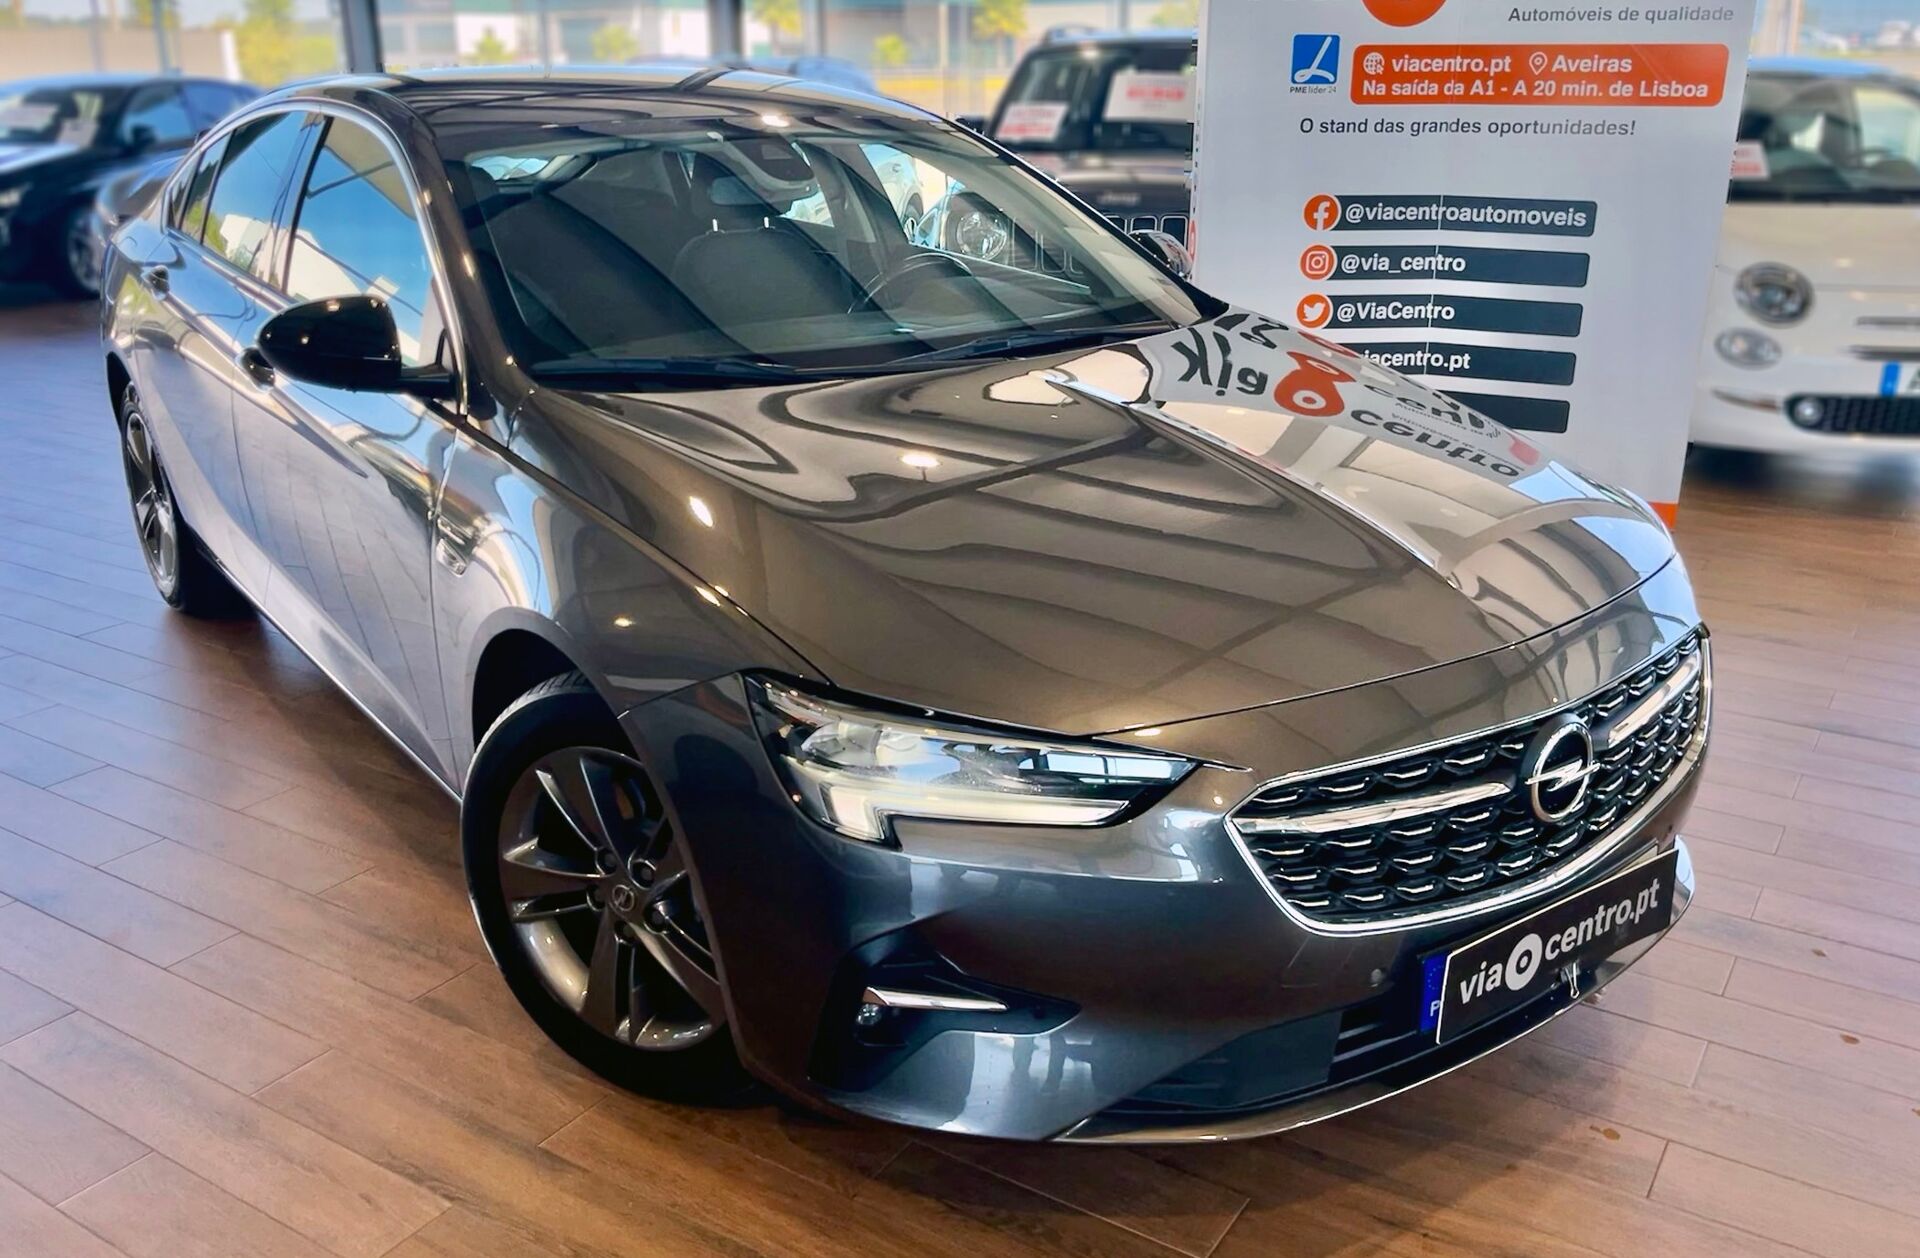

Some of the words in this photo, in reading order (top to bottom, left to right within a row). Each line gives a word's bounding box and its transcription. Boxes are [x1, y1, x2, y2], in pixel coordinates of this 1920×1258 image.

[1508, 7, 1612, 22] Automóveis
[1618, 7, 1639, 21] de
[1645, 7, 1734, 24] qualidade
[1391, 54, 1511, 76] viacentro.pt
[1551, 54, 1633, 73] Aveiras
[1362, 80, 1387, 95] Na
[1391, 79, 1438, 96] saída
[1443, 79, 1466, 95] da
[1469, 80, 1495, 95] A1
[1512, 80, 1528, 96] A
[1533, 80, 1556, 96] 20
[1562, 80, 1602, 97] min.
[1609, 80, 1634, 97] de
[1639, 80, 1709, 97] Lisboa
[1300, 118, 1314, 133] O
[1319, 118, 1368, 134] stand
[1373, 118, 1405, 134] das
[1410, 118, 1481, 136] grandes
[1487, 119, 1636, 137] oportunidades!
[1345, 202, 1587, 227] @viacentroautomoveis
[1341, 253, 1466, 274] @via_centro
[1337, 301, 1455, 323] @ViaCentro
